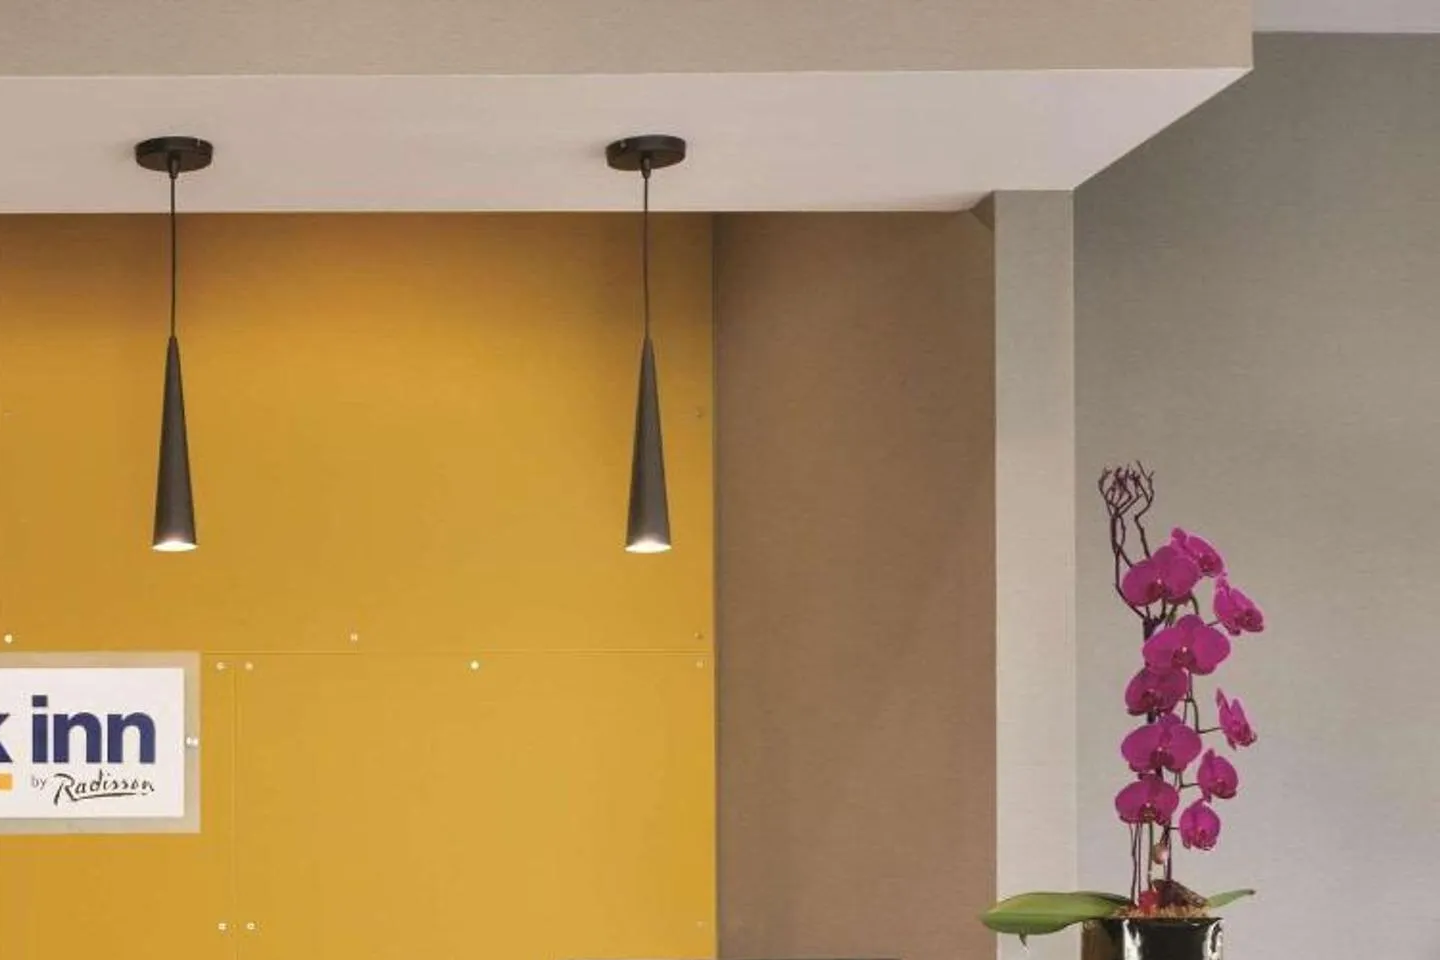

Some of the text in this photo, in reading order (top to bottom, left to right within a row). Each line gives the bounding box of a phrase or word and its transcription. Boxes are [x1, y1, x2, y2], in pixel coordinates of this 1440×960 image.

[31, 695, 156, 764] inn
[31, 769, 155, 806] by Radisson
